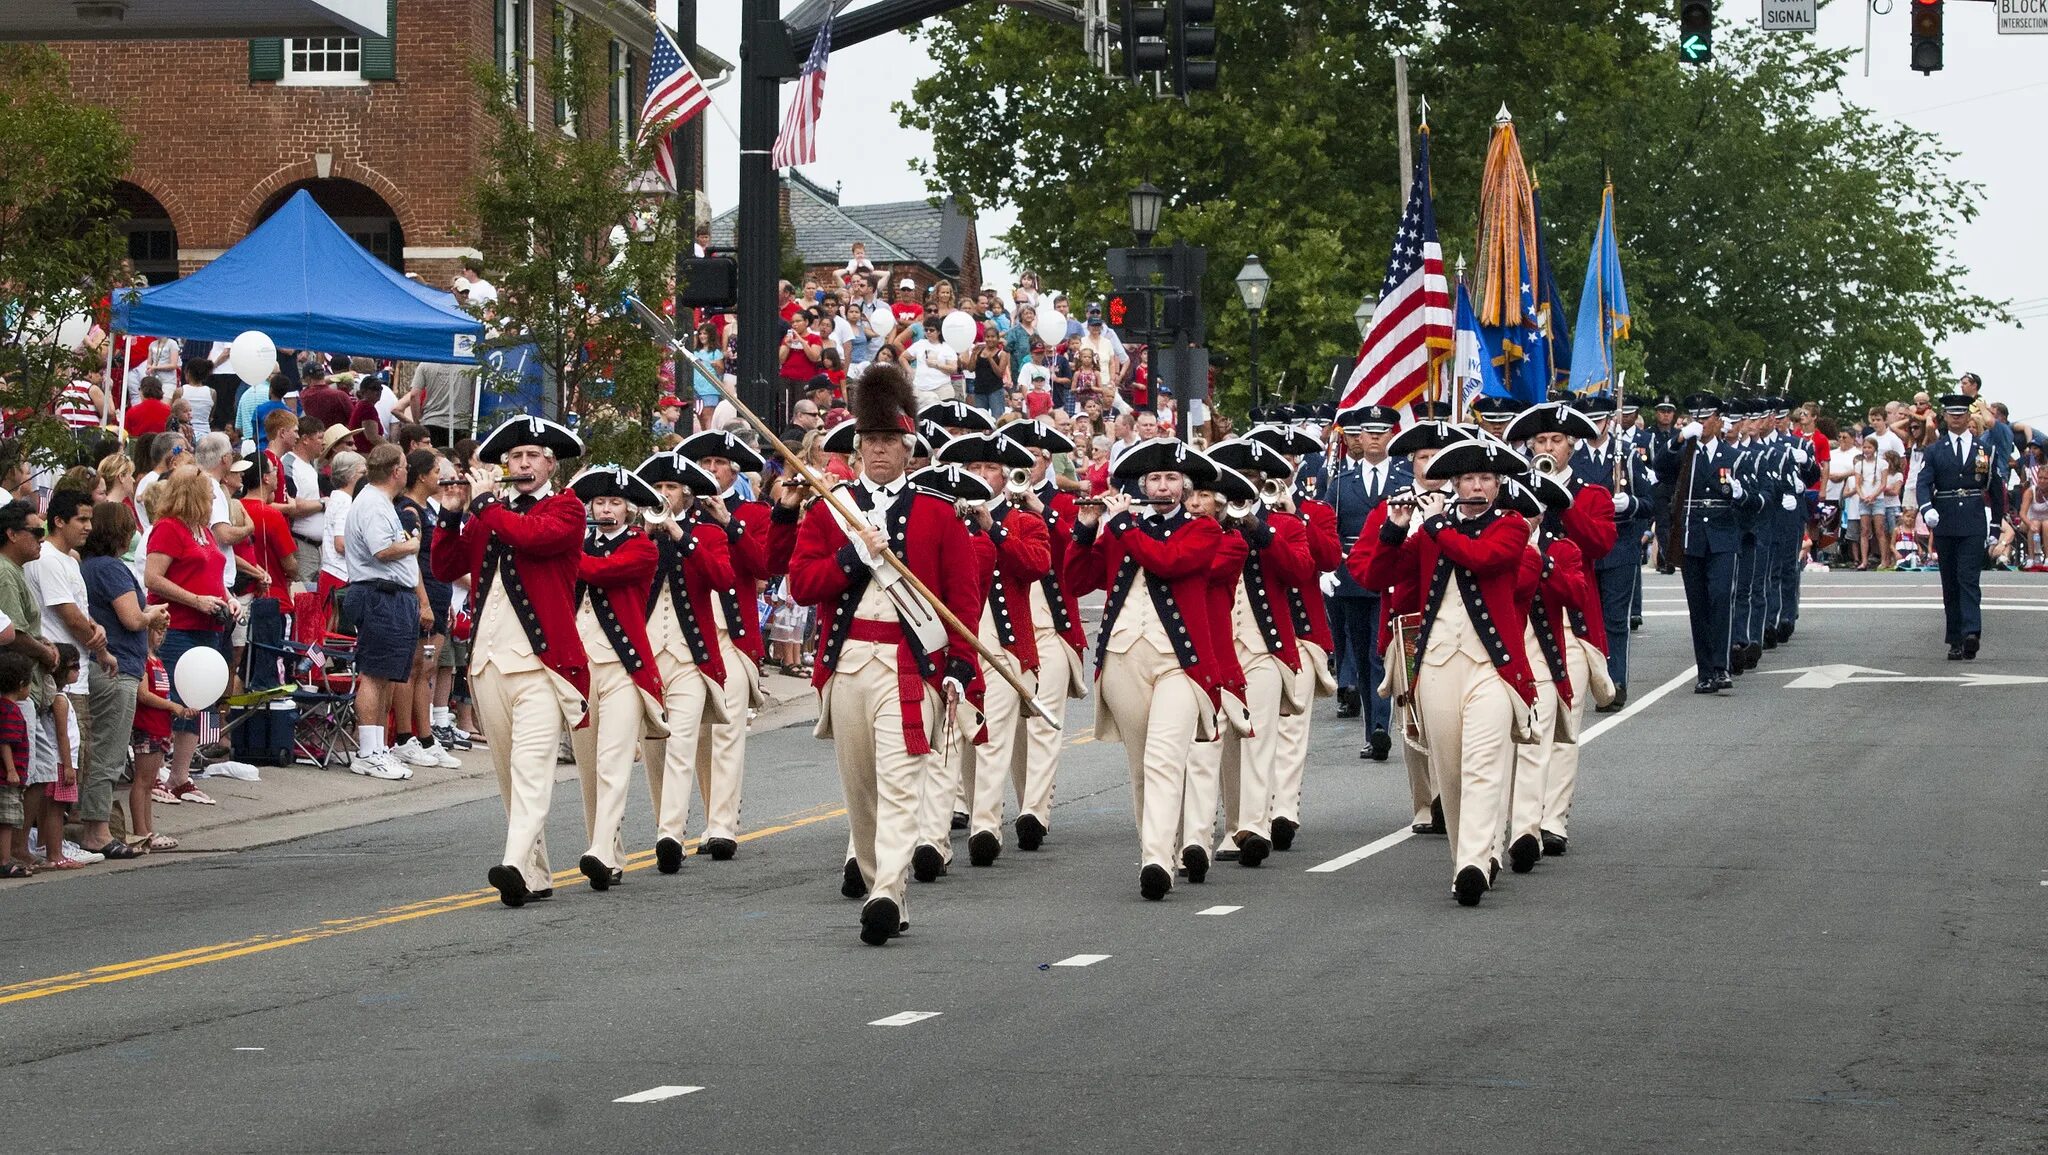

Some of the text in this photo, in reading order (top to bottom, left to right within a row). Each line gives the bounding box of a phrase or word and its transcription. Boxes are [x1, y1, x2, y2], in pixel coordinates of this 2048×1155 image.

[2002, 0, 2048, 13] BLOCK
[1767, 10, 1811, 23] SIGNAL
[2001, 18, 2048, 28] INTERSECTION
